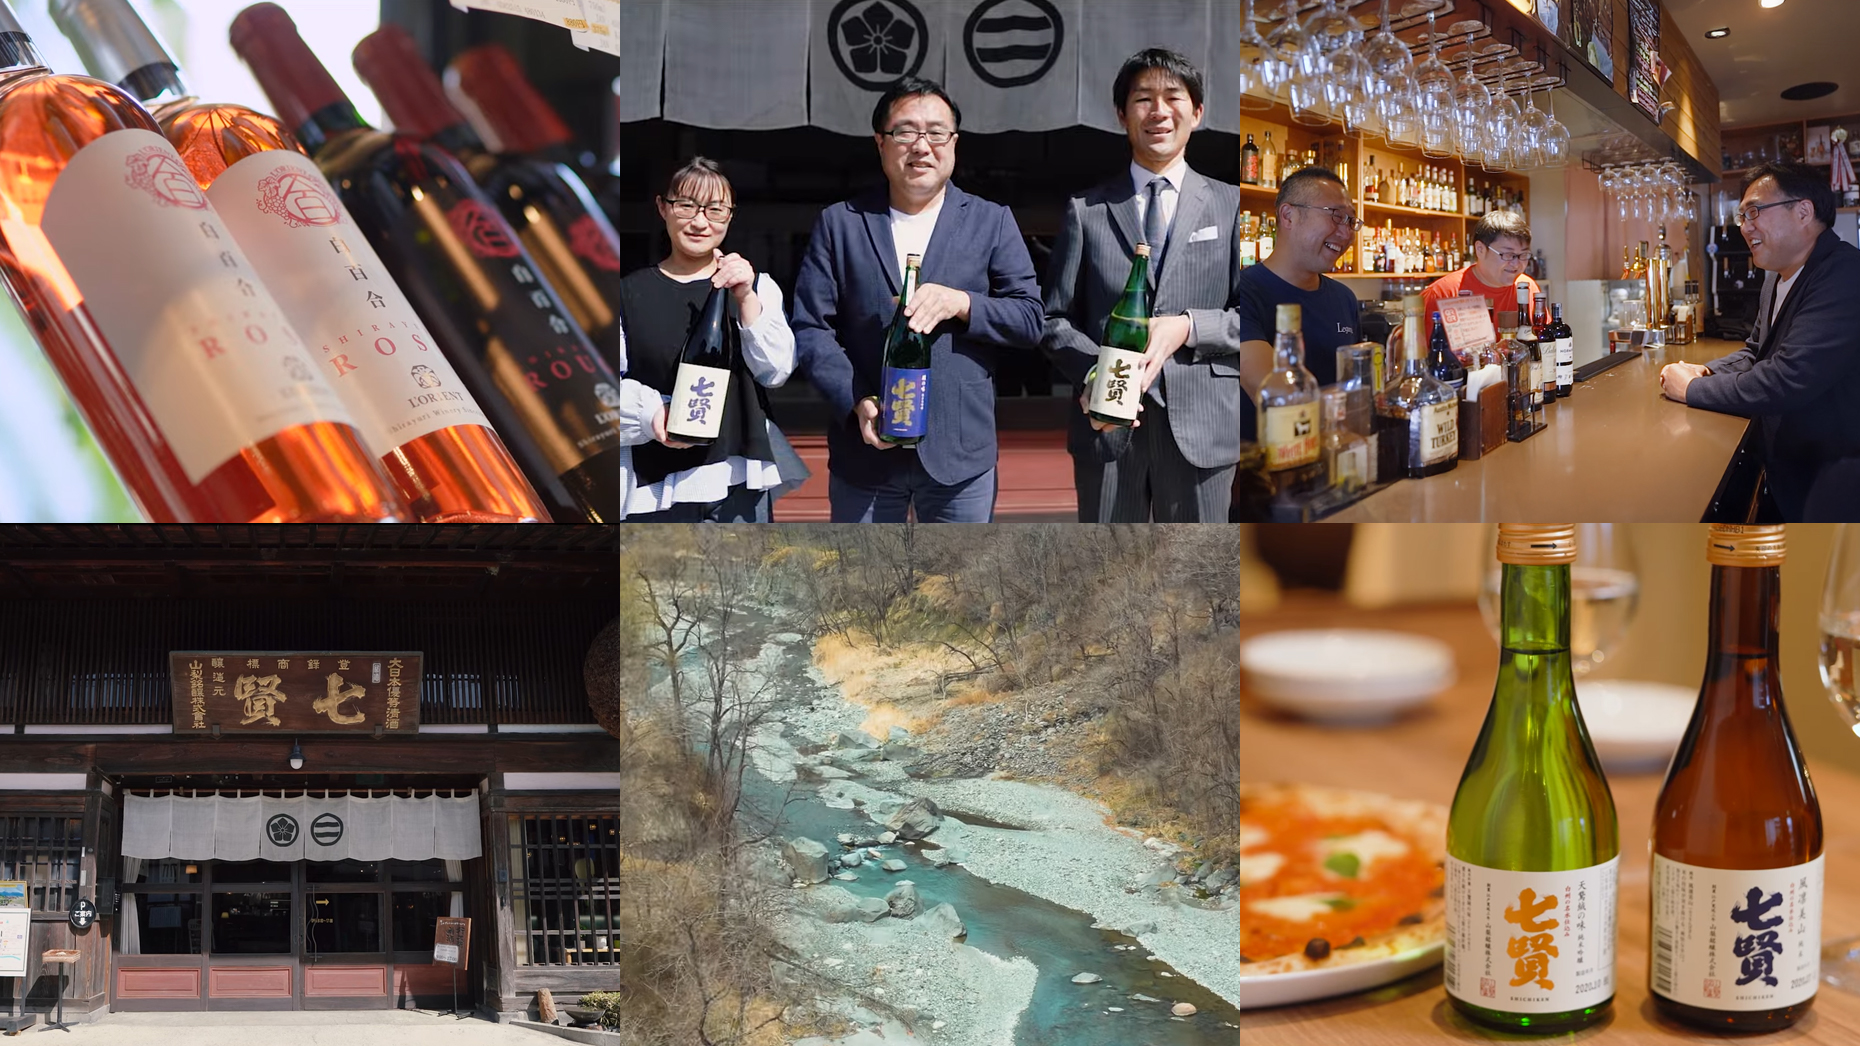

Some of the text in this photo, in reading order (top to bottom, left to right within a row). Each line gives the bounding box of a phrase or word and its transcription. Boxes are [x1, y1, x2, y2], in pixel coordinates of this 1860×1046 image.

[329, 236, 386, 309] 白百合
[687, 377, 715, 425] 七賢
[891, 378, 916, 427] 七賢
[1105, 358, 1131, 405] 七賢
[1437, 419, 1454, 434] WILD
[1503, 887, 1559, 991] 七賢
[1730, 886, 1784, 987] 七賢
